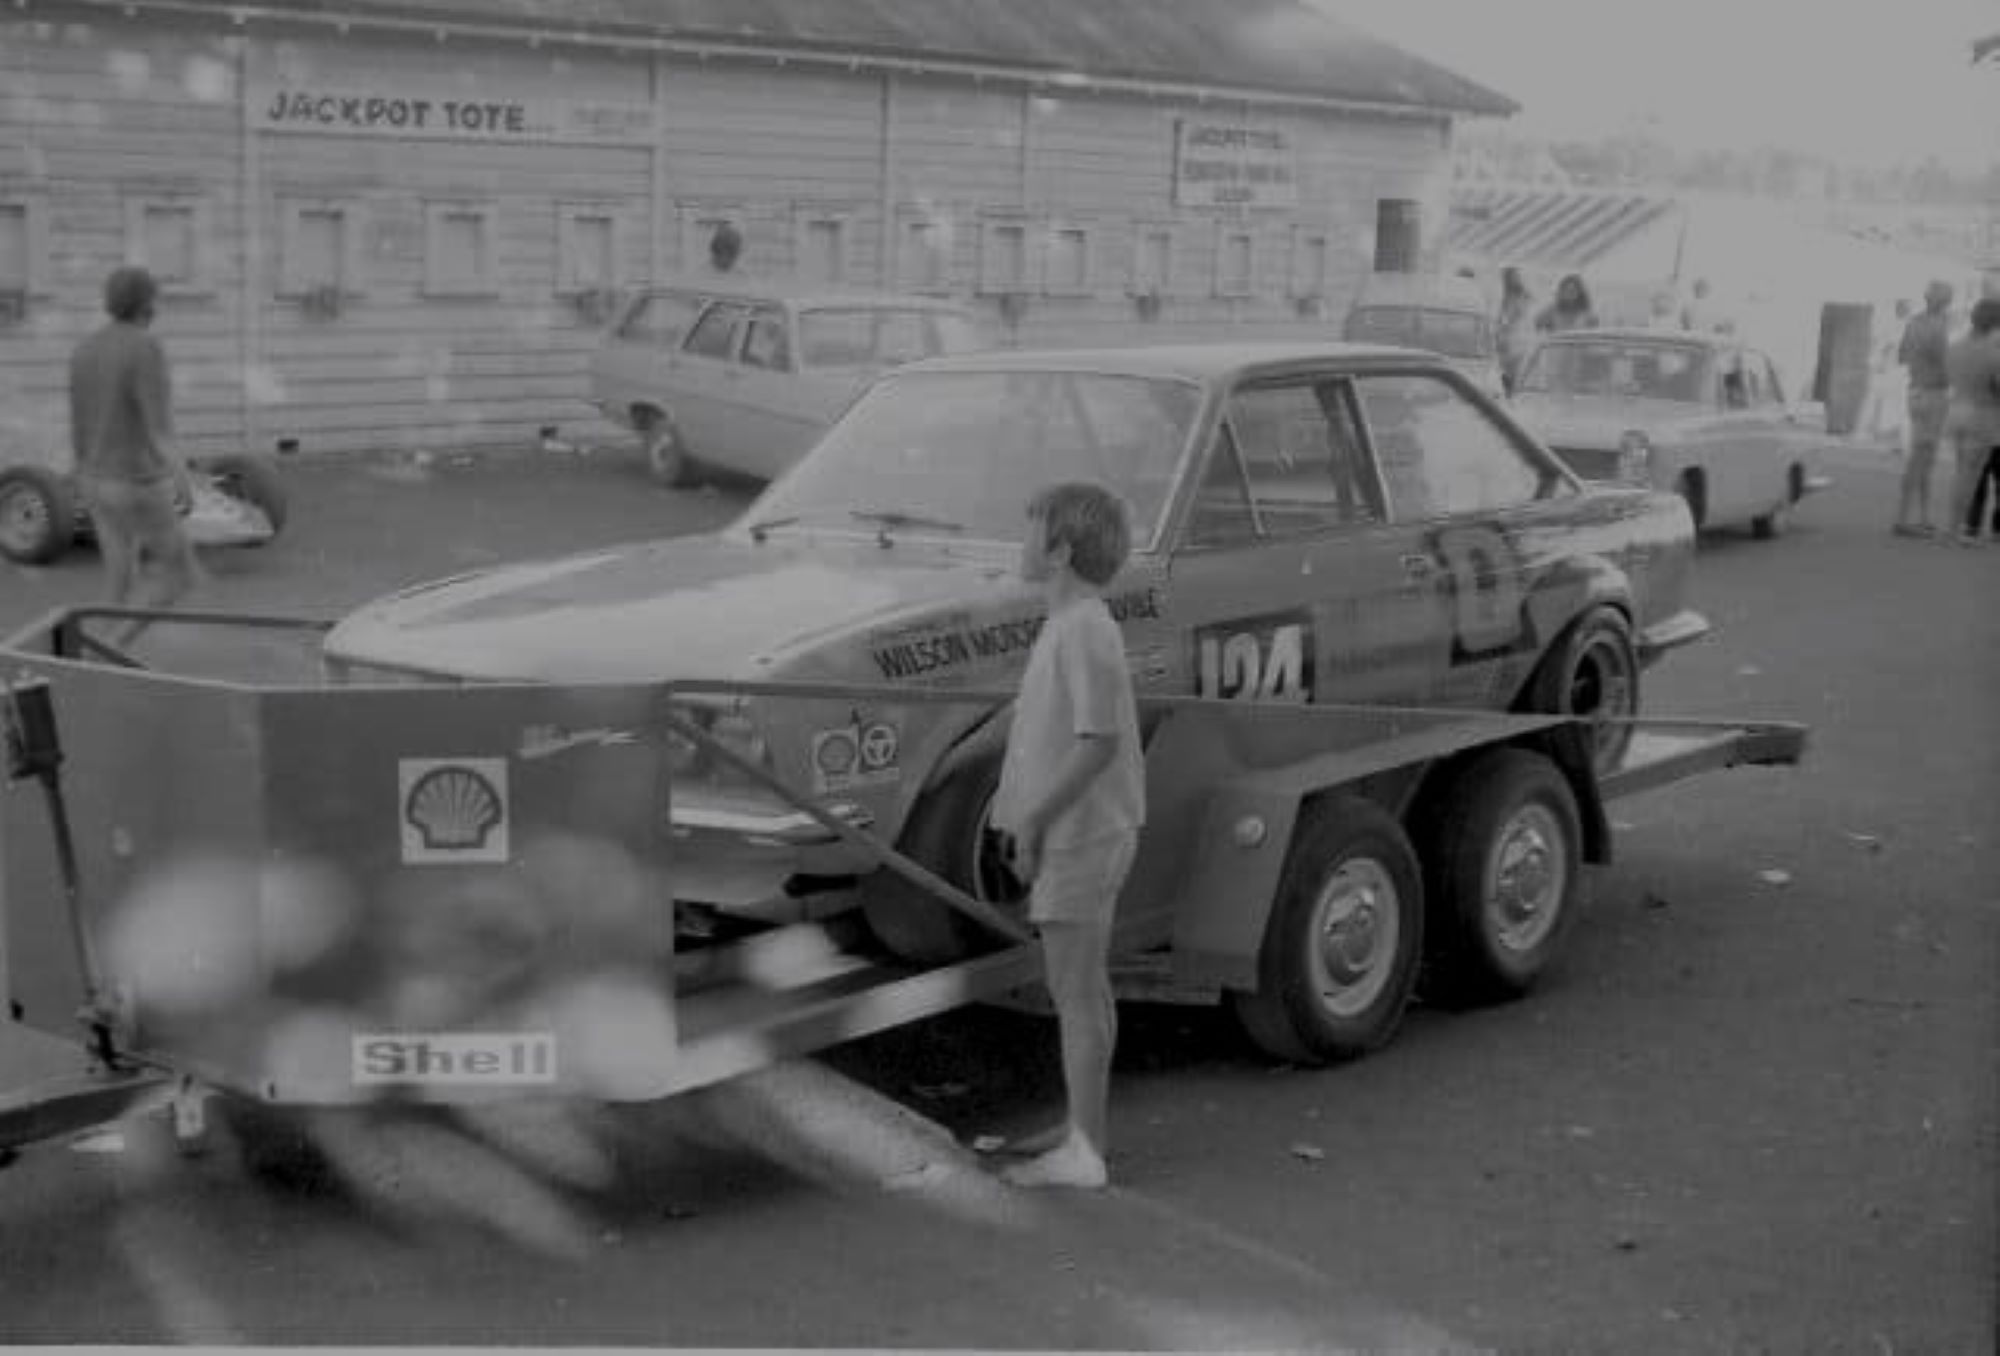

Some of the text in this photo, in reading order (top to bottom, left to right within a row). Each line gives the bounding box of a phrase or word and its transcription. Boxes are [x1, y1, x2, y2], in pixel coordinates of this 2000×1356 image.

[268, 93, 526, 132] JACKPOT TOTE
[874, 630, 968, 678] WILSON
[364, 1040, 548, 1074] Shell
